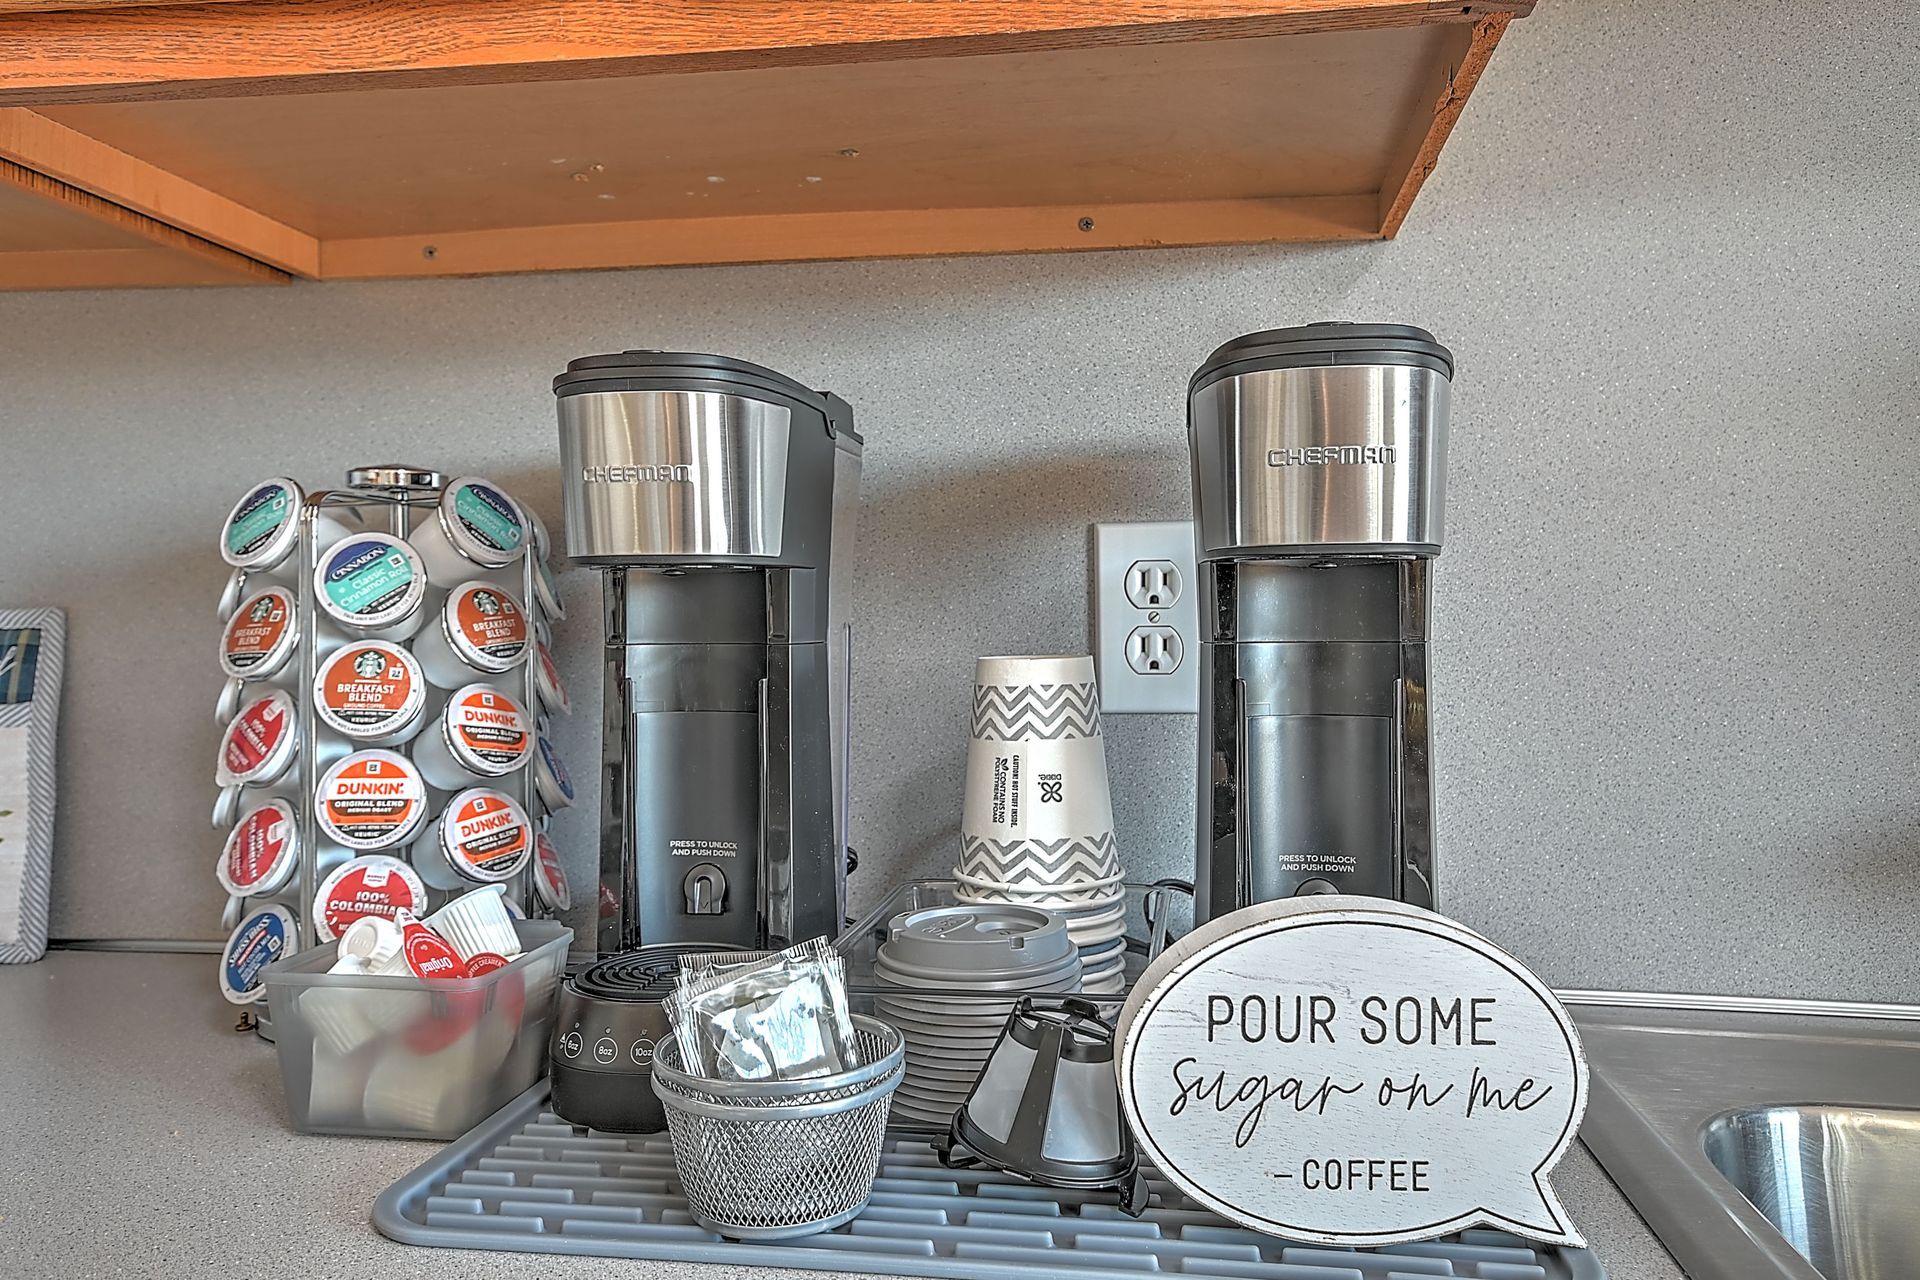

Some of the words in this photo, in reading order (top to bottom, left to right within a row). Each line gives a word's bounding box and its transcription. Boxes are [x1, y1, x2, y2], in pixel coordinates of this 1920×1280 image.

[1268, 445, 1396, 467] CHEFMAN
[582, 465, 692, 482] CHEFMAN
[331, 547, 386, 580] CINNABON
[352, 568, 386, 589] Classic
[341, 577, 389, 607] Cinnamon
[472, 619, 516, 632] BREAKFAST
[485, 628, 511, 638] BLEND
[337, 683, 396, 694] BREAKFAST
[348, 693, 382, 702] BLEND
[998, 811, 1005, 823] NO
[670, 840, 695, 848] PRESS
[696, 840, 708, 848] TO
[708, 841, 738, 849] UNLOCK
[671, 848, 690, 856] AND
[712, 849, 736, 857] DOWN
[1278, 854, 1304, 862] PRESS
[1320, 855, 1356, 864] UNLOCK
[1280, 863, 1299, 871] AND
[1325, 864, 1354, 872] DOWN
[356, 891, 391, 903] 100%
[330, 900, 396, 915] COLOMBIA
[419, 956, 453, 974] Original
[1206, 994, 1336, 1045] POUR
[1360, 994, 1497, 1047] SOME
[567, 1039, 578, 1051] 6oz
[598, 1045, 612, 1056] 8oz
[635, 1047, 652, 1056] 10oz
[1378, 1073, 1453, 1111] on
